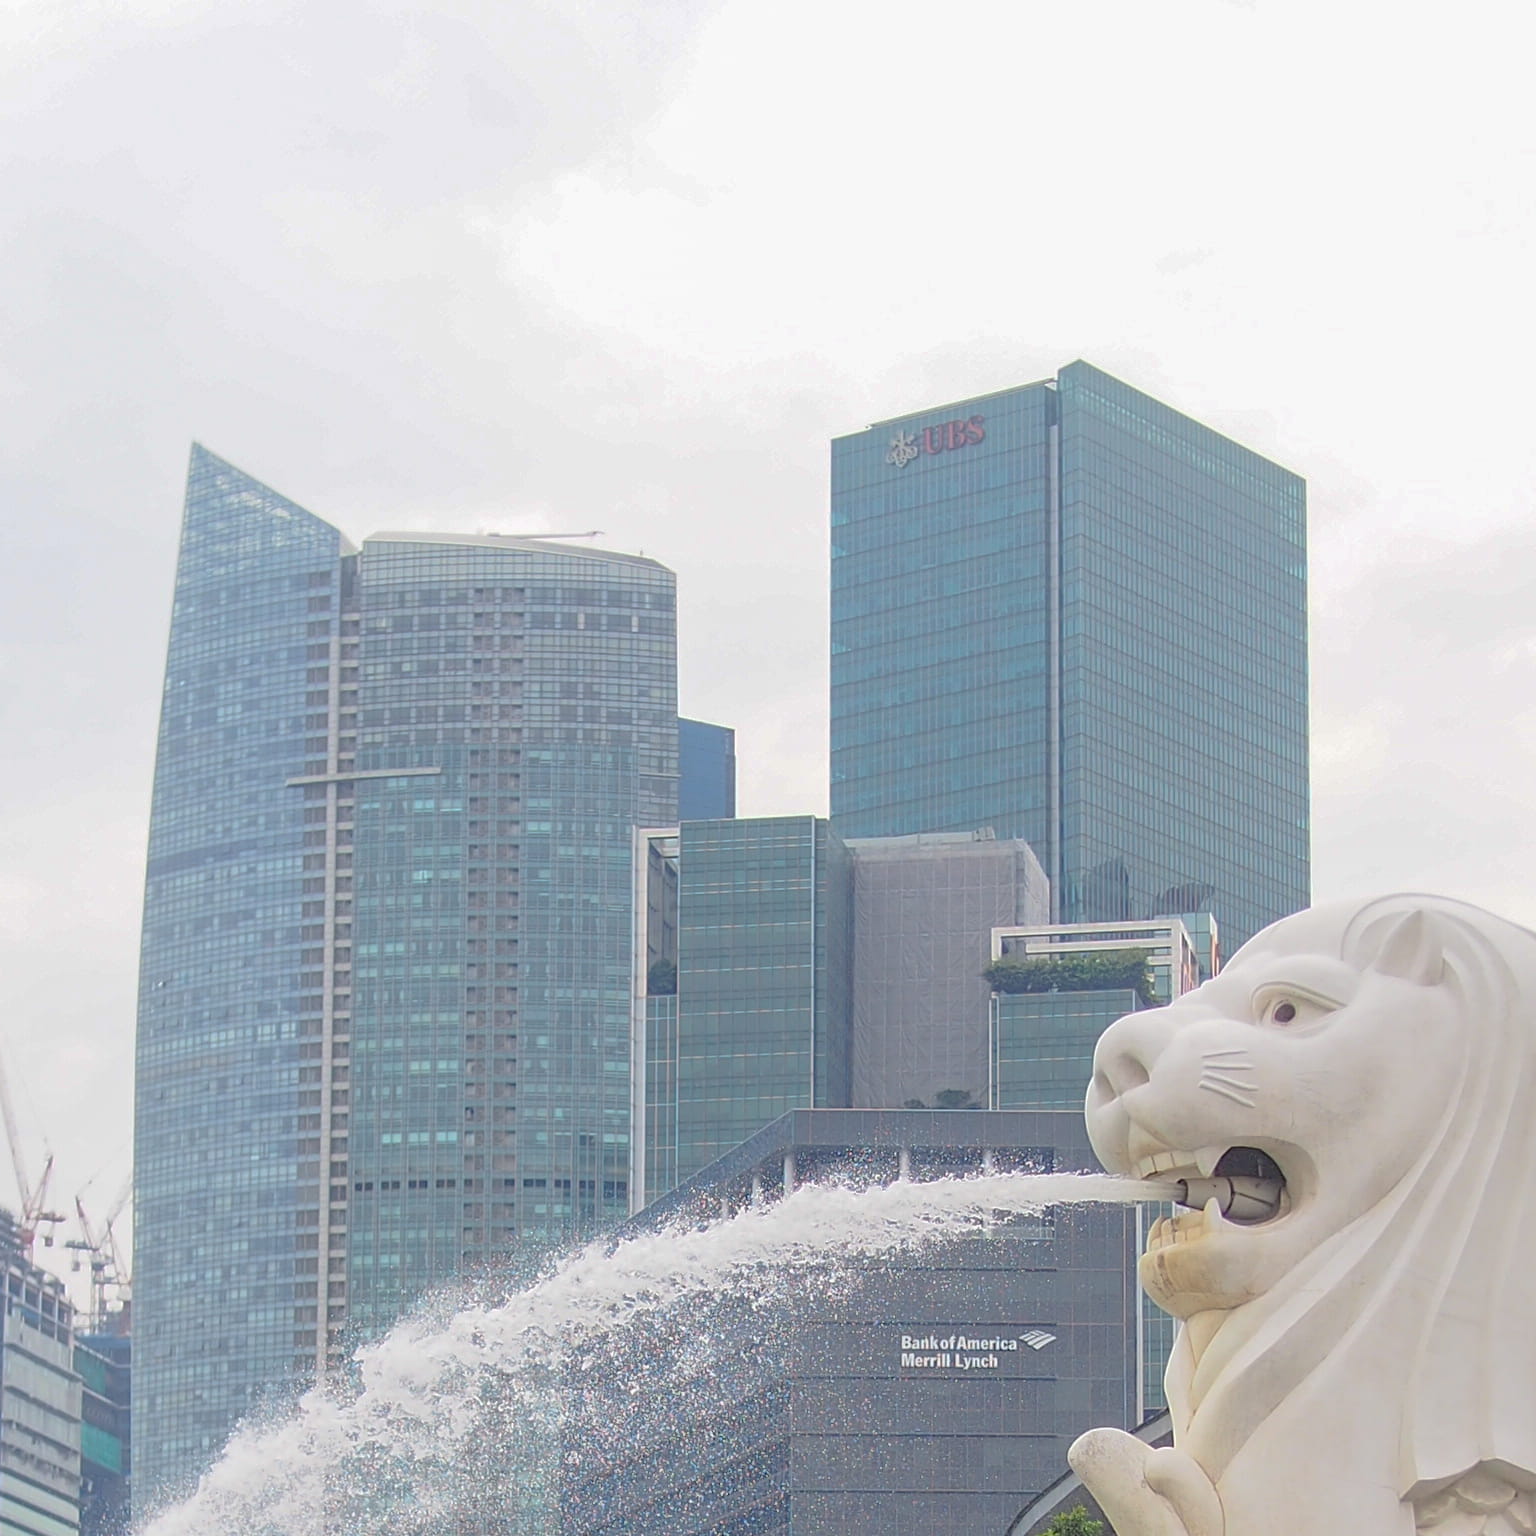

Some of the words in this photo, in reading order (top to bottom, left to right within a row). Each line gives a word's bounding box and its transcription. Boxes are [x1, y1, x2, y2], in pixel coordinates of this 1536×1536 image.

[923, 414, 986, 455] UBS
[901, 1335, 939, 1351] Bank
[941, 1335, 957, 1351] of
[957, 1335, 1018, 1351] America
[901, 1353, 951, 1369] Merrill
[954, 1353, 999, 1371] Lynch
